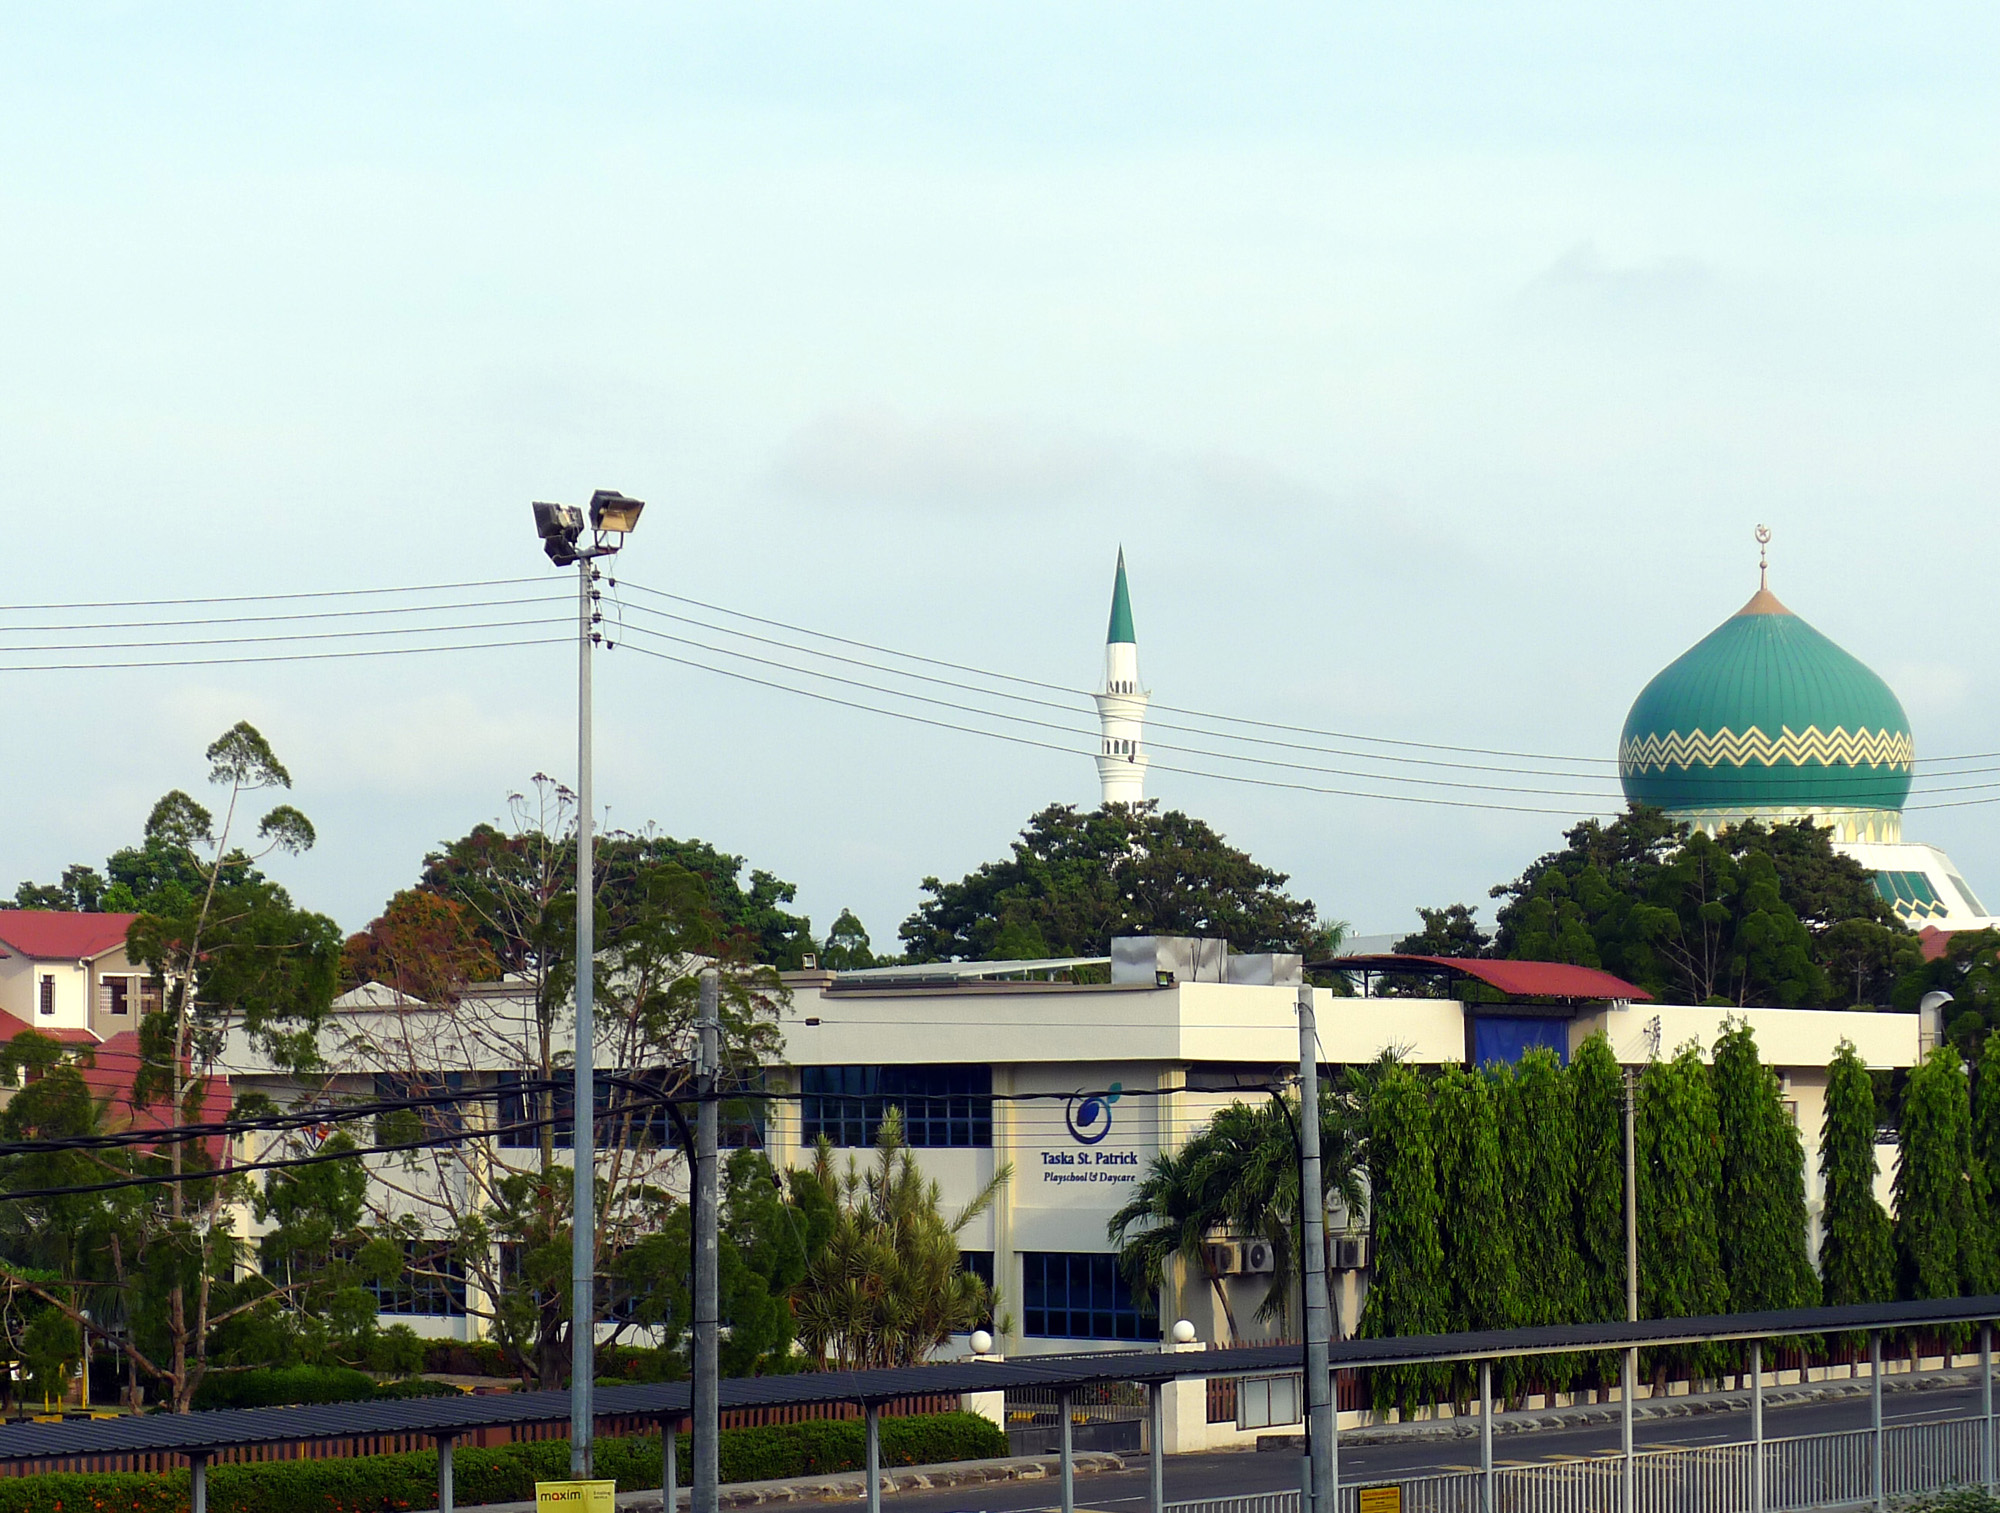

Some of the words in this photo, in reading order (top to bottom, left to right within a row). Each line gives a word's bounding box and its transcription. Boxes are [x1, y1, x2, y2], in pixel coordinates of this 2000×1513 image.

[1041, 1152, 1074, 1164] Taska
[1077, 1152, 1092, 1164] St.
[1095, 1151, 1138, 1164] Patrick
[1043, 1172, 1088, 1185] Playschool
[1089, 1172, 1098, 1182] &
[1099, 1172, 1135, 1185] Daycare
[540, 1489, 581, 1501] maxim
